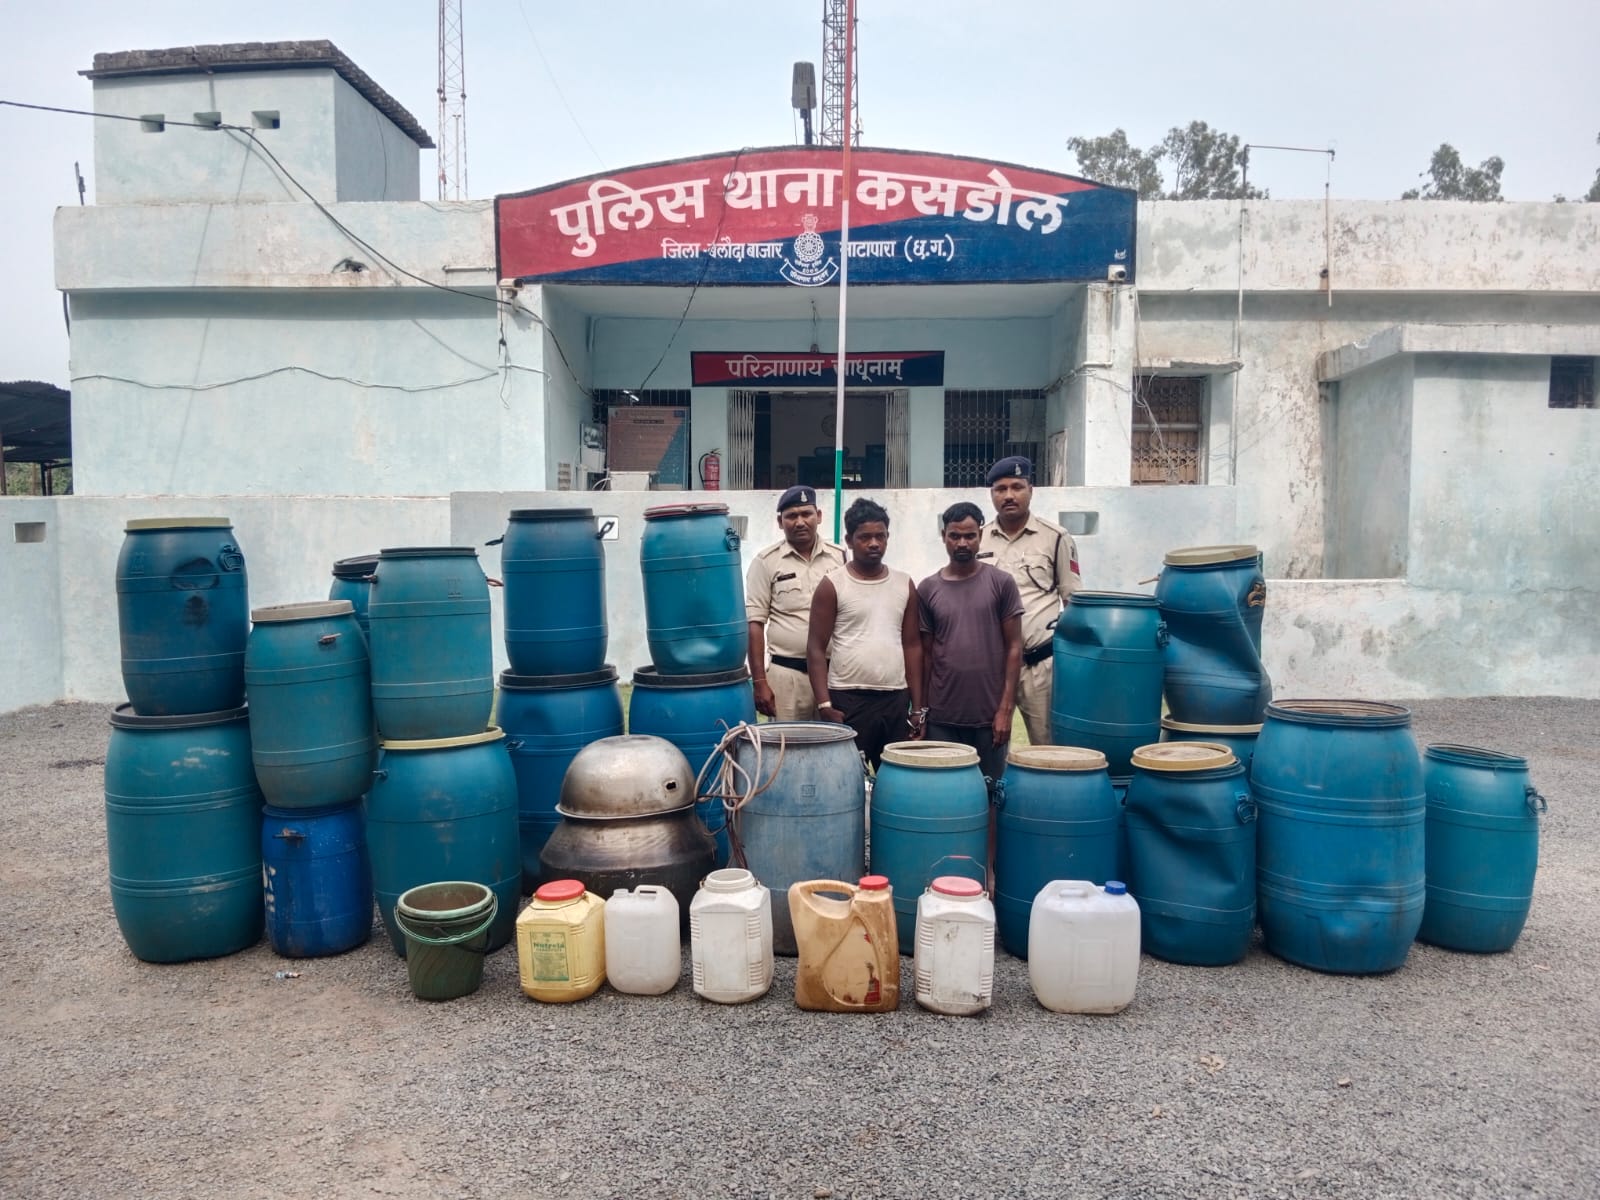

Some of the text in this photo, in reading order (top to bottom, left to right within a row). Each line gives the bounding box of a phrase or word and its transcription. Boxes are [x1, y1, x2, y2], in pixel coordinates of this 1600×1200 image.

[550, 168, 1069, 257] पुलिस थाना कसडोल
[660, 237, 702, 259] जिला
[725, 354, 825, 378] परित्राणाय
